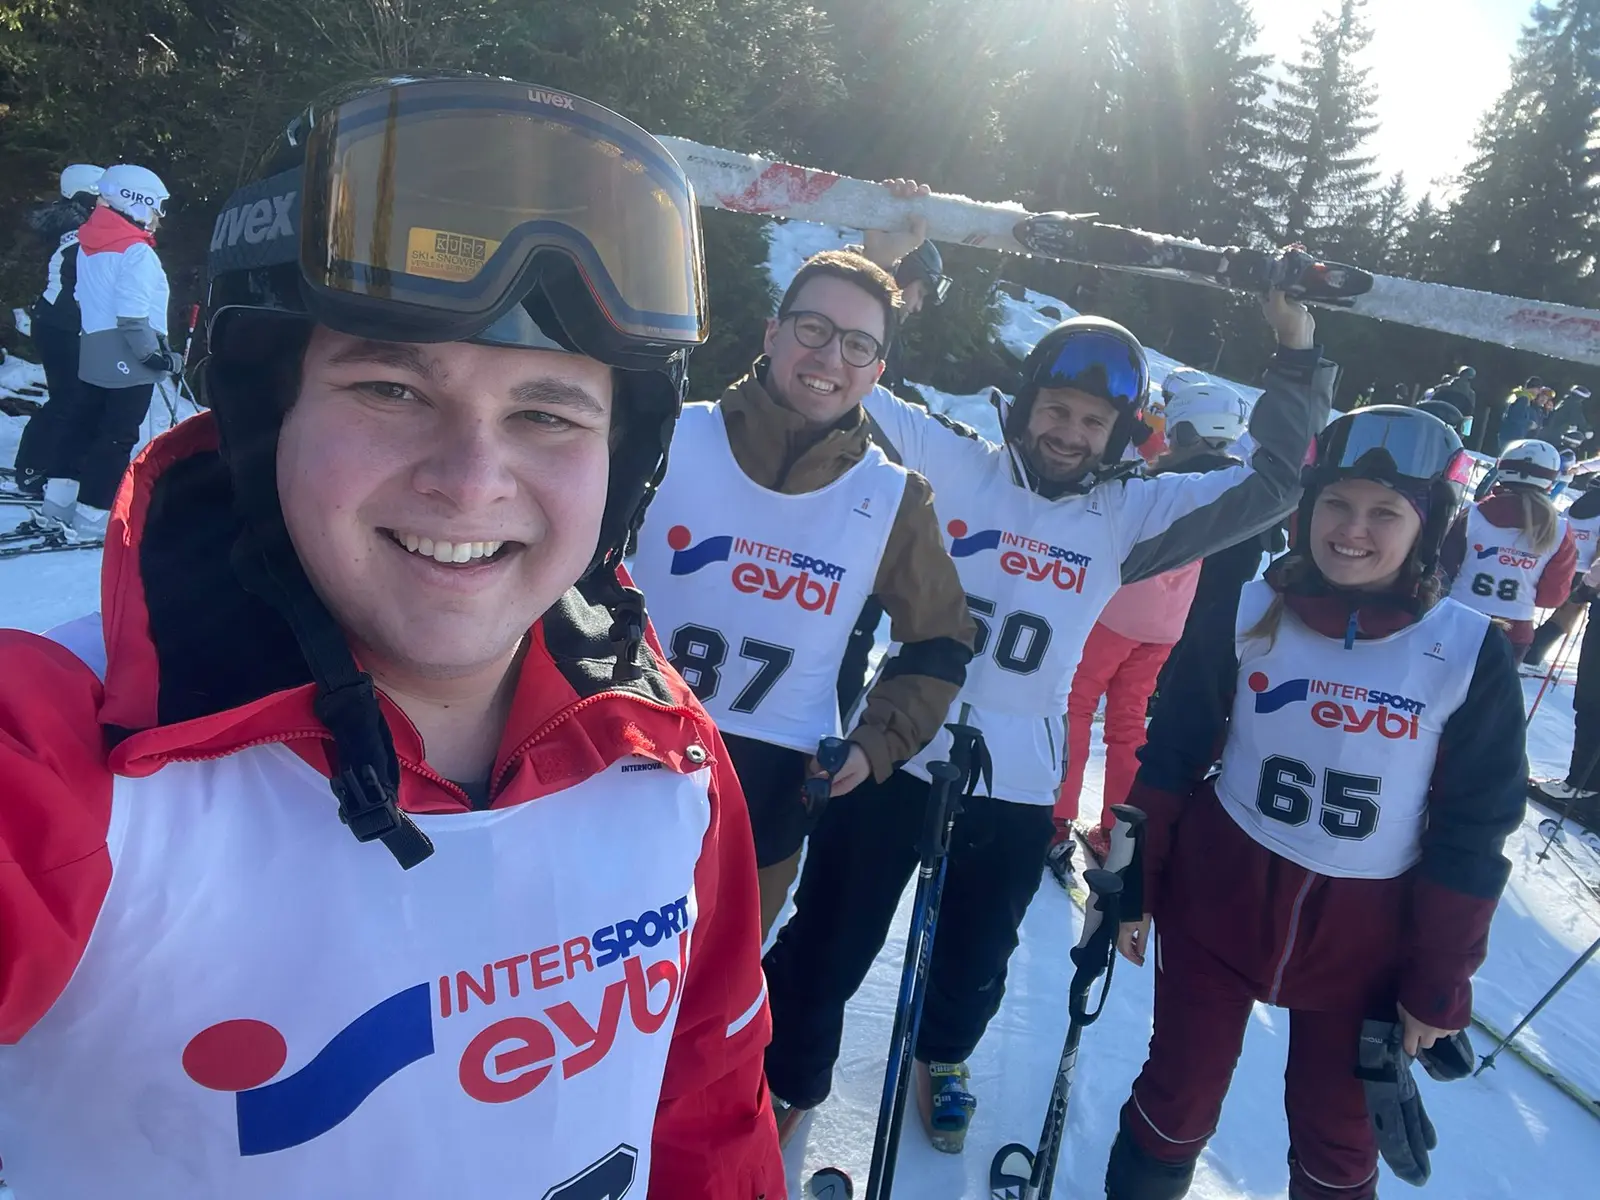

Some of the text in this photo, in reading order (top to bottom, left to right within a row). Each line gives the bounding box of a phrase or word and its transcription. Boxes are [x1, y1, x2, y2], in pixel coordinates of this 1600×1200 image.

[527, 89, 575, 111] uvex
[120, 188, 155, 206] GIRO
[210, 190, 298, 252] uvex
[411, 250, 430, 260] SKI
[436, 235, 486, 260] KURZ
[734, 537, 847, 582] INTERSPORT
[1001, 531, 1092, 568] INTERSPORT
[731, 562, 840, 616] eybl
[1000, 551, 1087, 594] eybl
[1471, 572, 1520, 601] 68
[668, 622, 795, 715] 87
[1310, 679, 1427, 717] INTERSPORT
[1310, 700, 1421, 740] eybl
[621, 762, 663, 773] INTERNOVA
[1255, 753, 1382, 842] 65
[439, 894, 689, 1018] INTERSPORT
